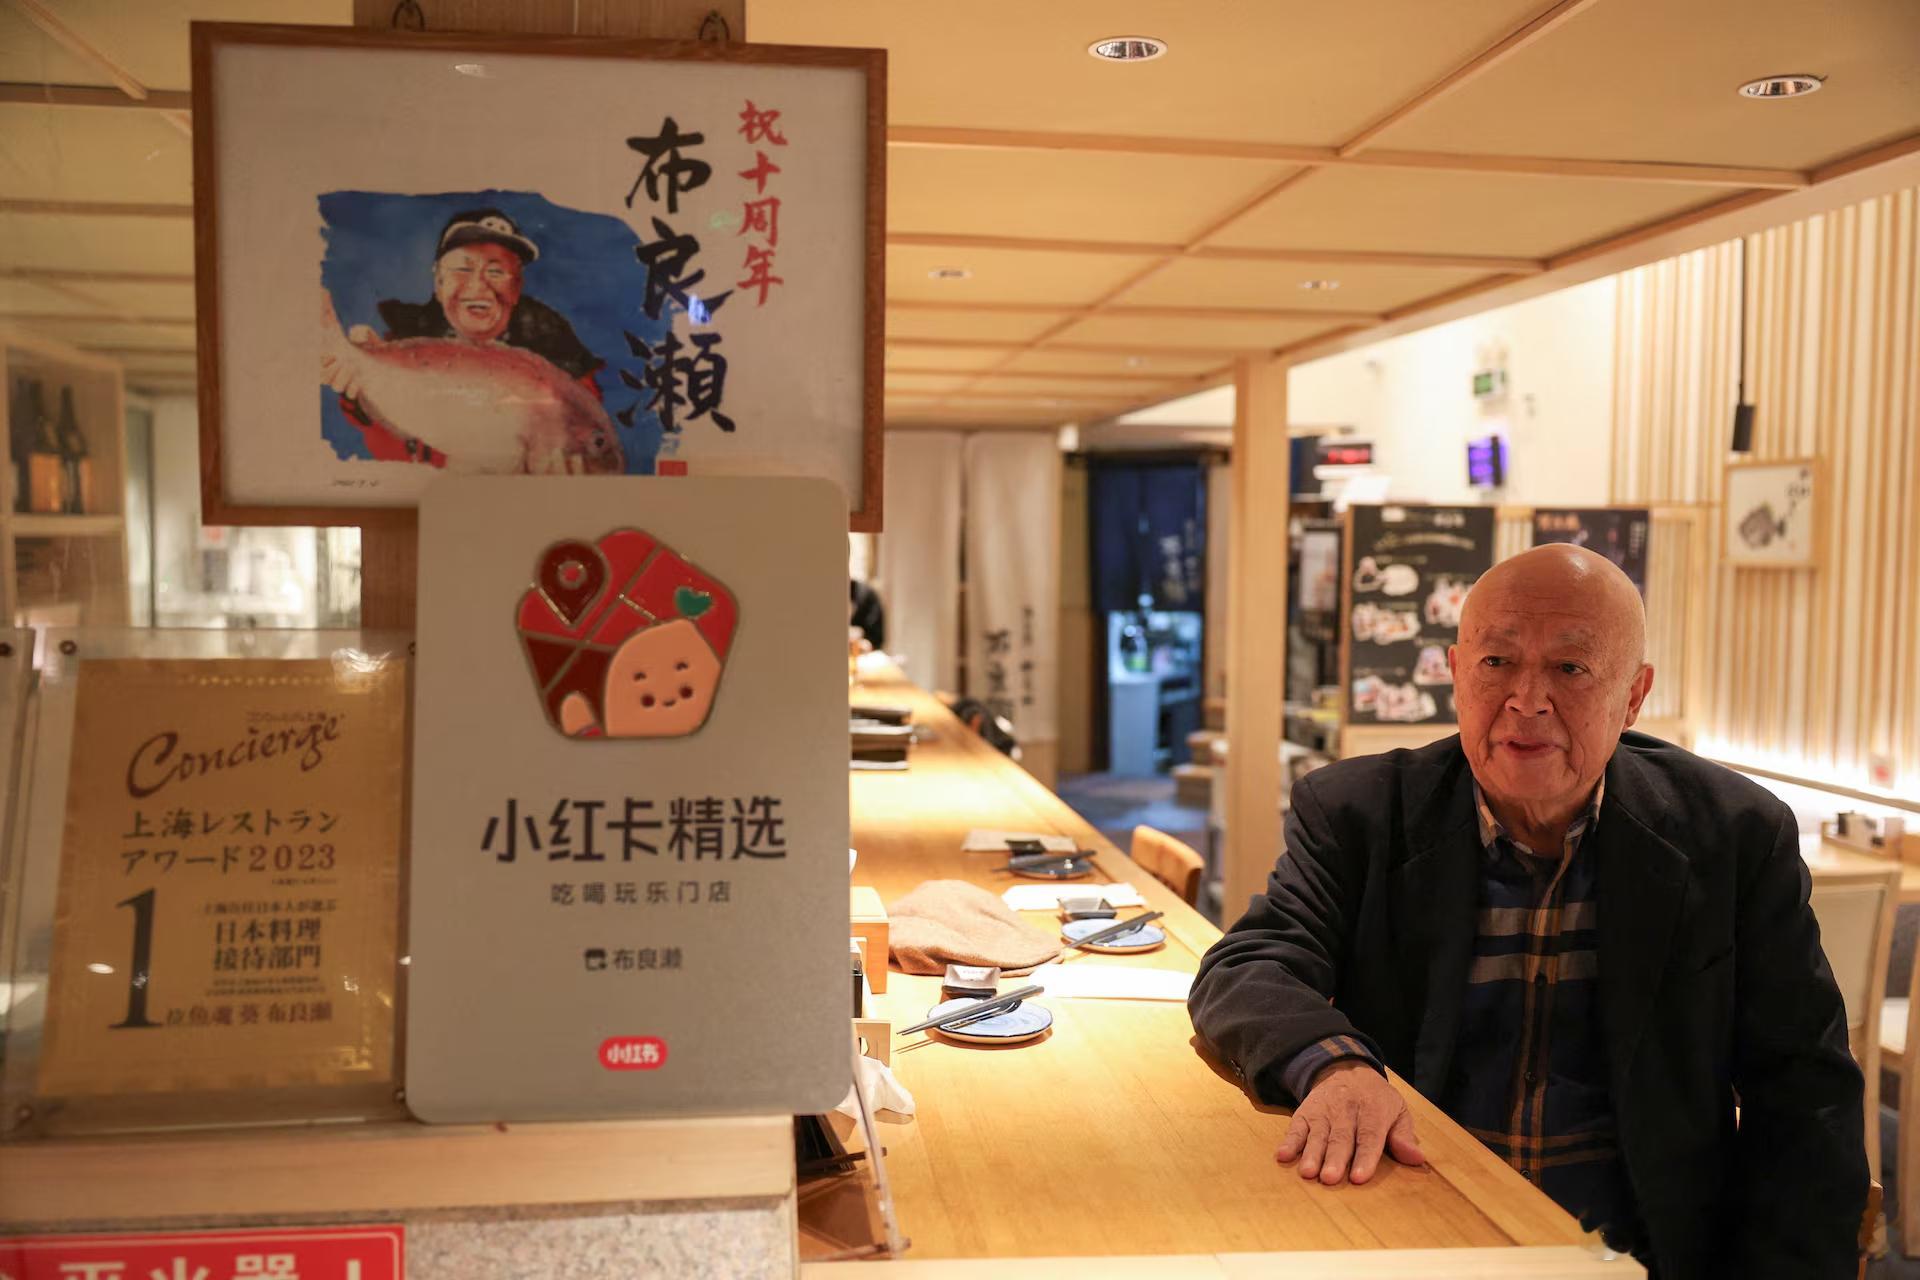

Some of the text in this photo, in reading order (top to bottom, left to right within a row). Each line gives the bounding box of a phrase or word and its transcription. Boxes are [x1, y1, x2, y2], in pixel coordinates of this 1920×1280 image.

[736, 99, 789, 308] 祝十周年
[126, 717, 342, 799] Concierge
[122, 808, 341, 840] 上海レストラン
[480, 795, 787, 864] 小红卡精选
[119, 843, 336, 875] アワード 2023
[550, 880, 732, 906] 吃喝玩乐门店
[215, 917, 321, 945] 日本料理
